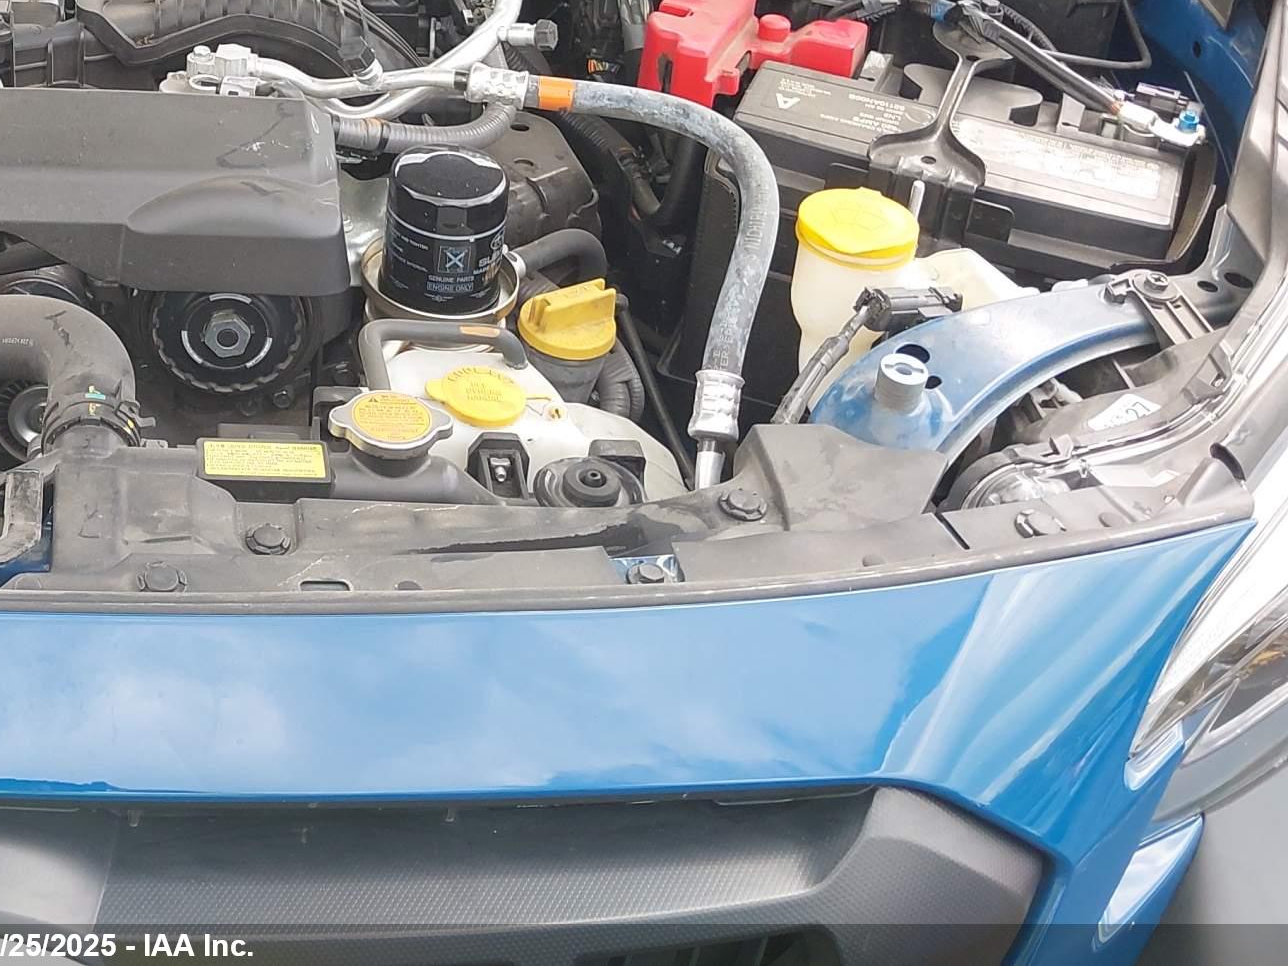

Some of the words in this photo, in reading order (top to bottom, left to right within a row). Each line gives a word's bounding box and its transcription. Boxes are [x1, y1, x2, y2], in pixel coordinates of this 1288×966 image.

[428, 274, 455, 283] GENUINE
[428, 282, 454, 291] ENGINE
[455, 283, 473, 291] ONLY
